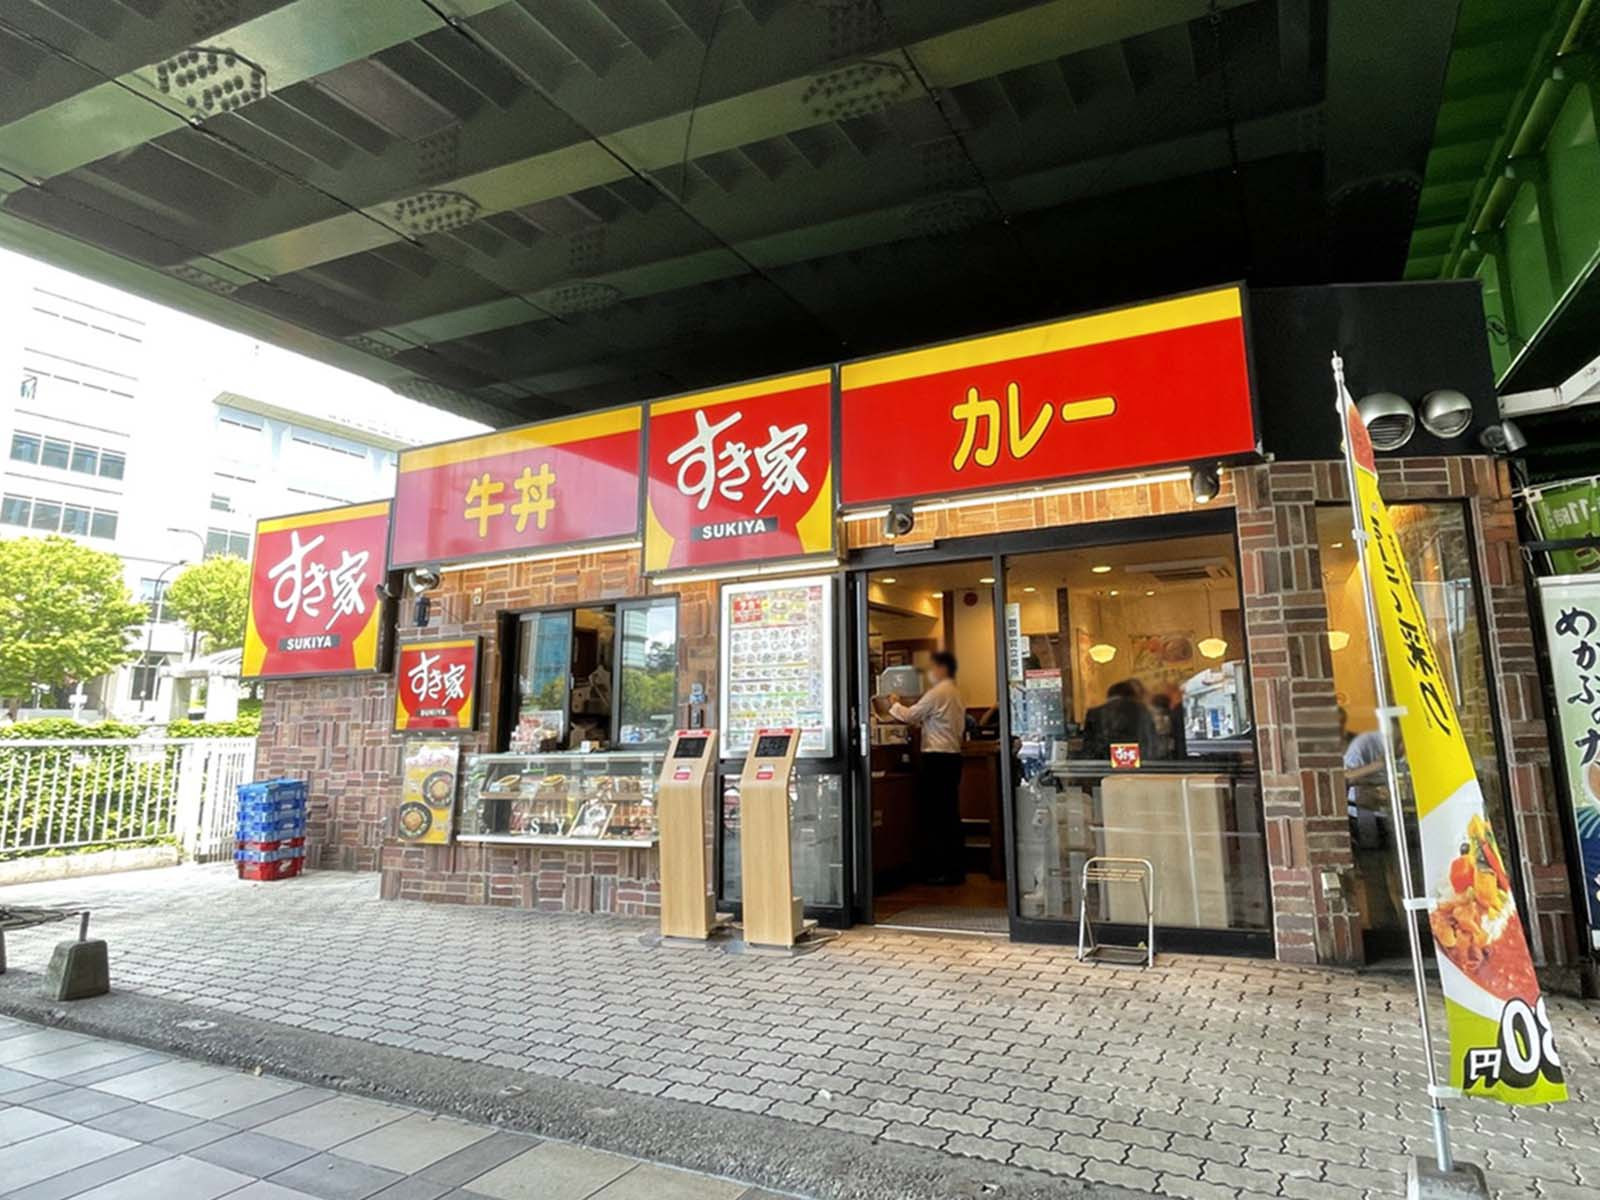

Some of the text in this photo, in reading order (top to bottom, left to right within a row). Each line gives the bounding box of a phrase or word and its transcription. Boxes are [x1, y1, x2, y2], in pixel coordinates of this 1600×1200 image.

[666, 409, 810, 514] すき家
[952, 382, 1116, 471] カレー
[463, 463, 556, 537] 牛丼
[702, 519, 767, 540] SUKIYA
[267, 530, 370, 631] すき家
[286, 635, 332, 651] SUKIYA
[407, 651, 466, 707] すき家
